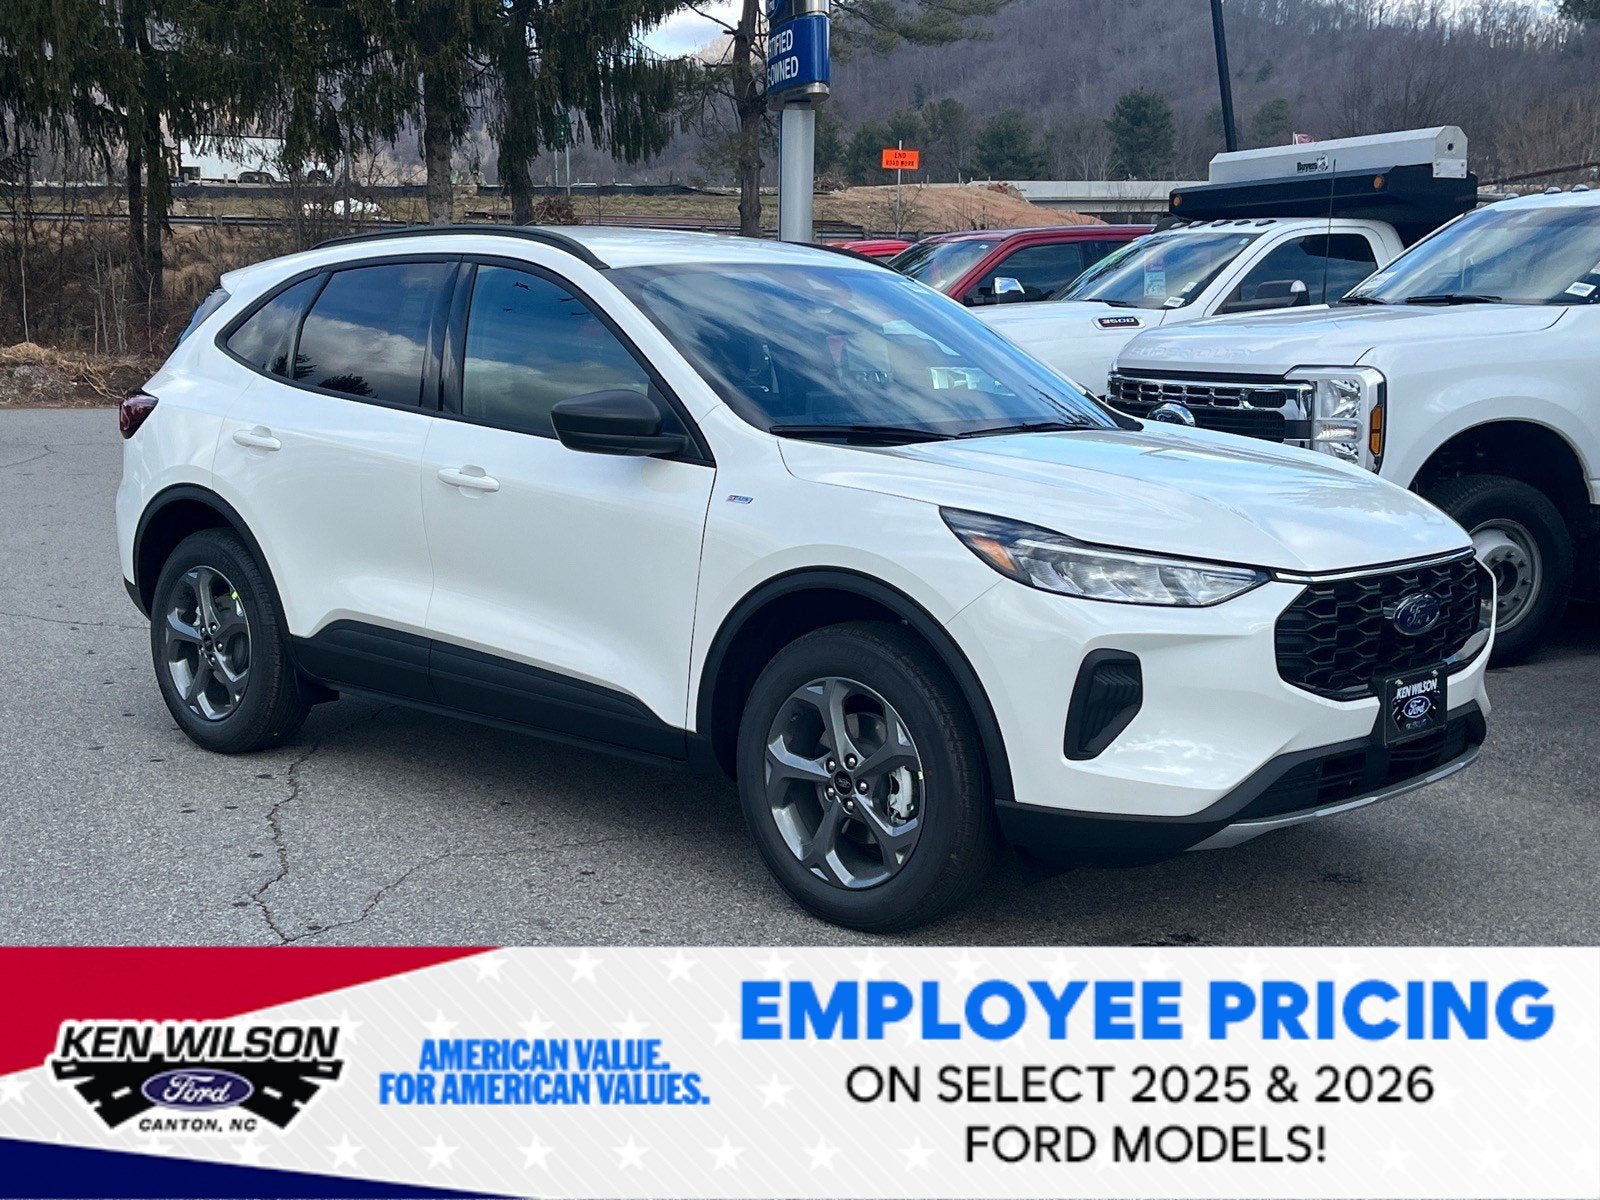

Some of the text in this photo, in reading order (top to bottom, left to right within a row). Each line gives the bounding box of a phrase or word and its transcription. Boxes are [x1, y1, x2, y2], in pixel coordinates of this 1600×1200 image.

[1396, 678, 1437, 699] KEN WILSON
[1408, 699, 1426, 715] Ford
